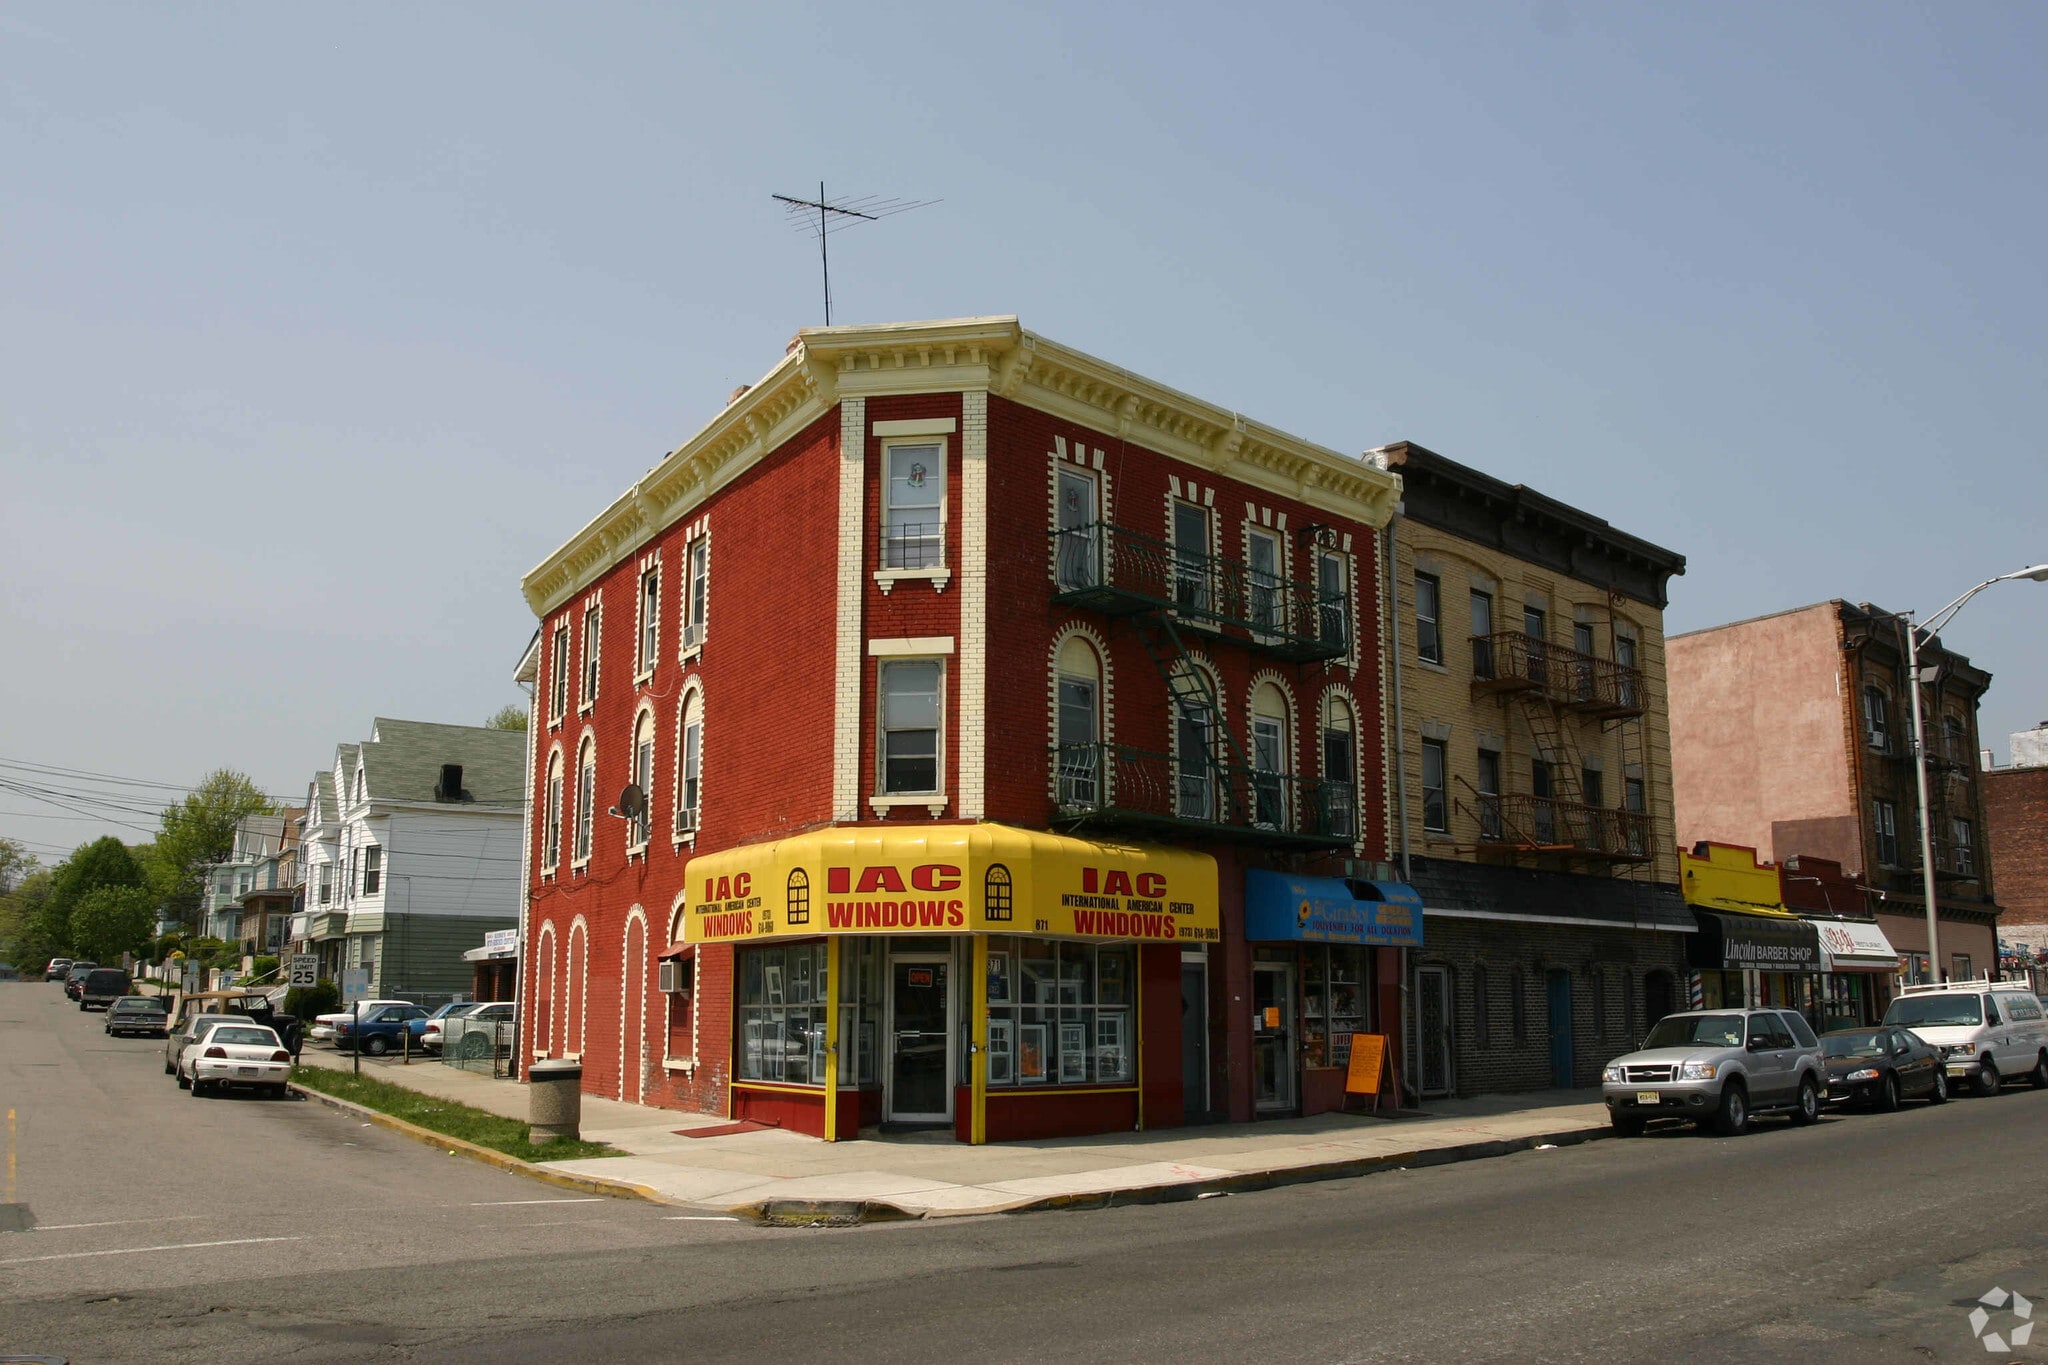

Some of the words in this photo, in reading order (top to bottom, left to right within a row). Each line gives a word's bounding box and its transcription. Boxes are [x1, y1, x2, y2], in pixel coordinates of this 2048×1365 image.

[705, 872, 751, 902] IAC
[828, 864, 962, 894] IAC
[1082, 867, 1167, 898] IAC
[827, 900, 964, 928] WINDOWS
[1061, 894, 1120, 910] INTERNATIONAL
[1127, 899, 1163, 913] AMERICAN
[1169, 902, 1194, 915] CENTER
[703, 911, 753, 938] WINDOWS
[1035, 919, 1048, 931] 871
[1073, 910, 1176, 939] WINDOWS
[1352, 921, 1364, 933] FOR
[1725, 938, 1756, 960] Lincoln
[1757, 946, 1789, 961] BARBER
[1789, 947, 1812, 961] SHOP
[293, 971, 314, 984] 25
[911, 972, 930, 984] OPEN
